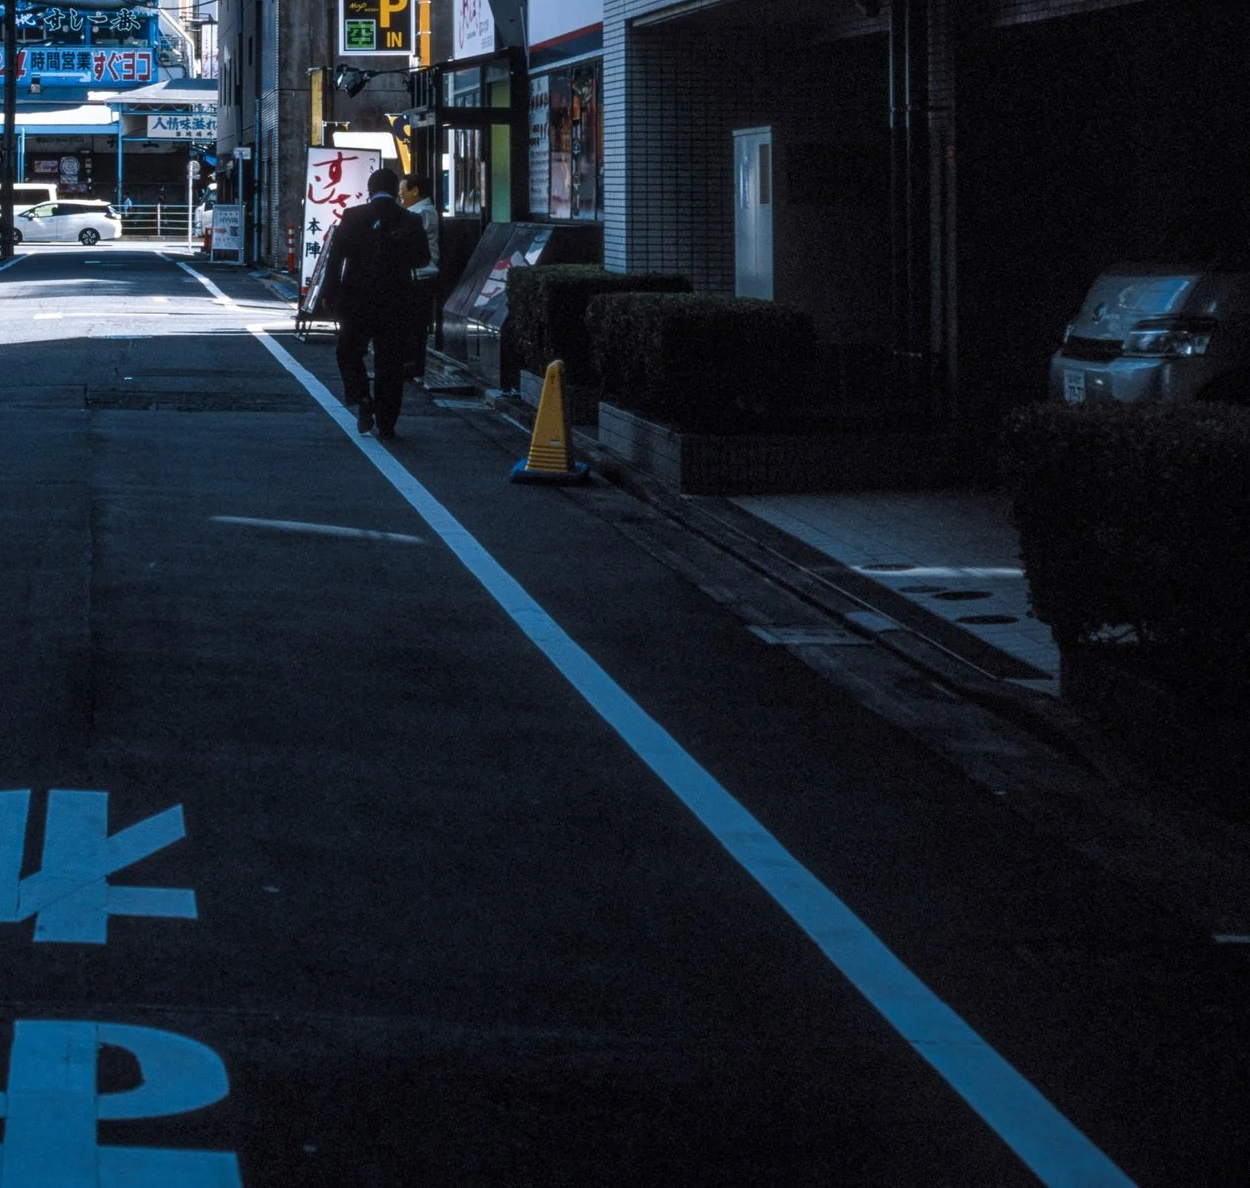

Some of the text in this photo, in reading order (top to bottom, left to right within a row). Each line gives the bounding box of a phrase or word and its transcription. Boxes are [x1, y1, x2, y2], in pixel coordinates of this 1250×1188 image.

[43, 7, 141, 32] すし一番
[386, 31, 403, 48] IN
[92, 51, 151, 81] すぐヨコ
[306, 217, 323, 259] 本陣
